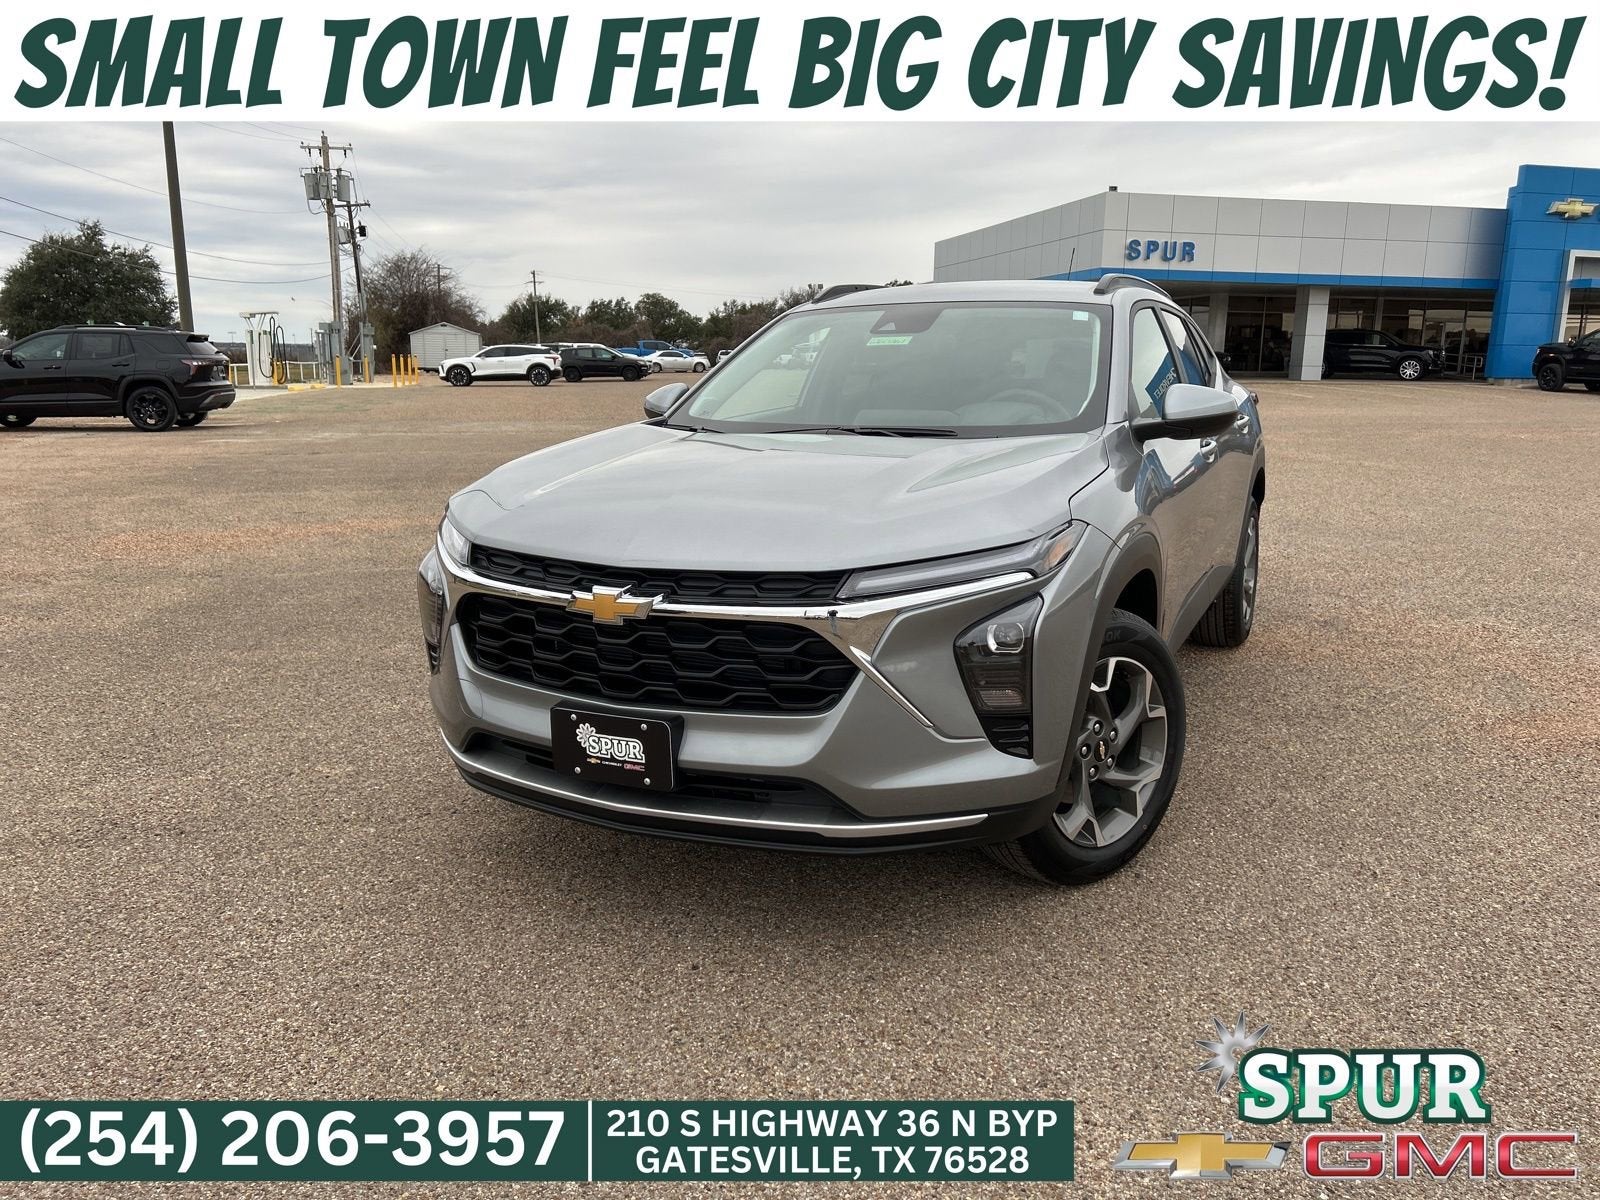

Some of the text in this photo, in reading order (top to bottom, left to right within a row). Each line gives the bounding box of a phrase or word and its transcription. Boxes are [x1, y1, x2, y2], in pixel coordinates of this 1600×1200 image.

[1126, 239, 1196, 262] SPUR
[587, 734, 643, 761] SPUR
[624, 763, 645, 771] GMC
